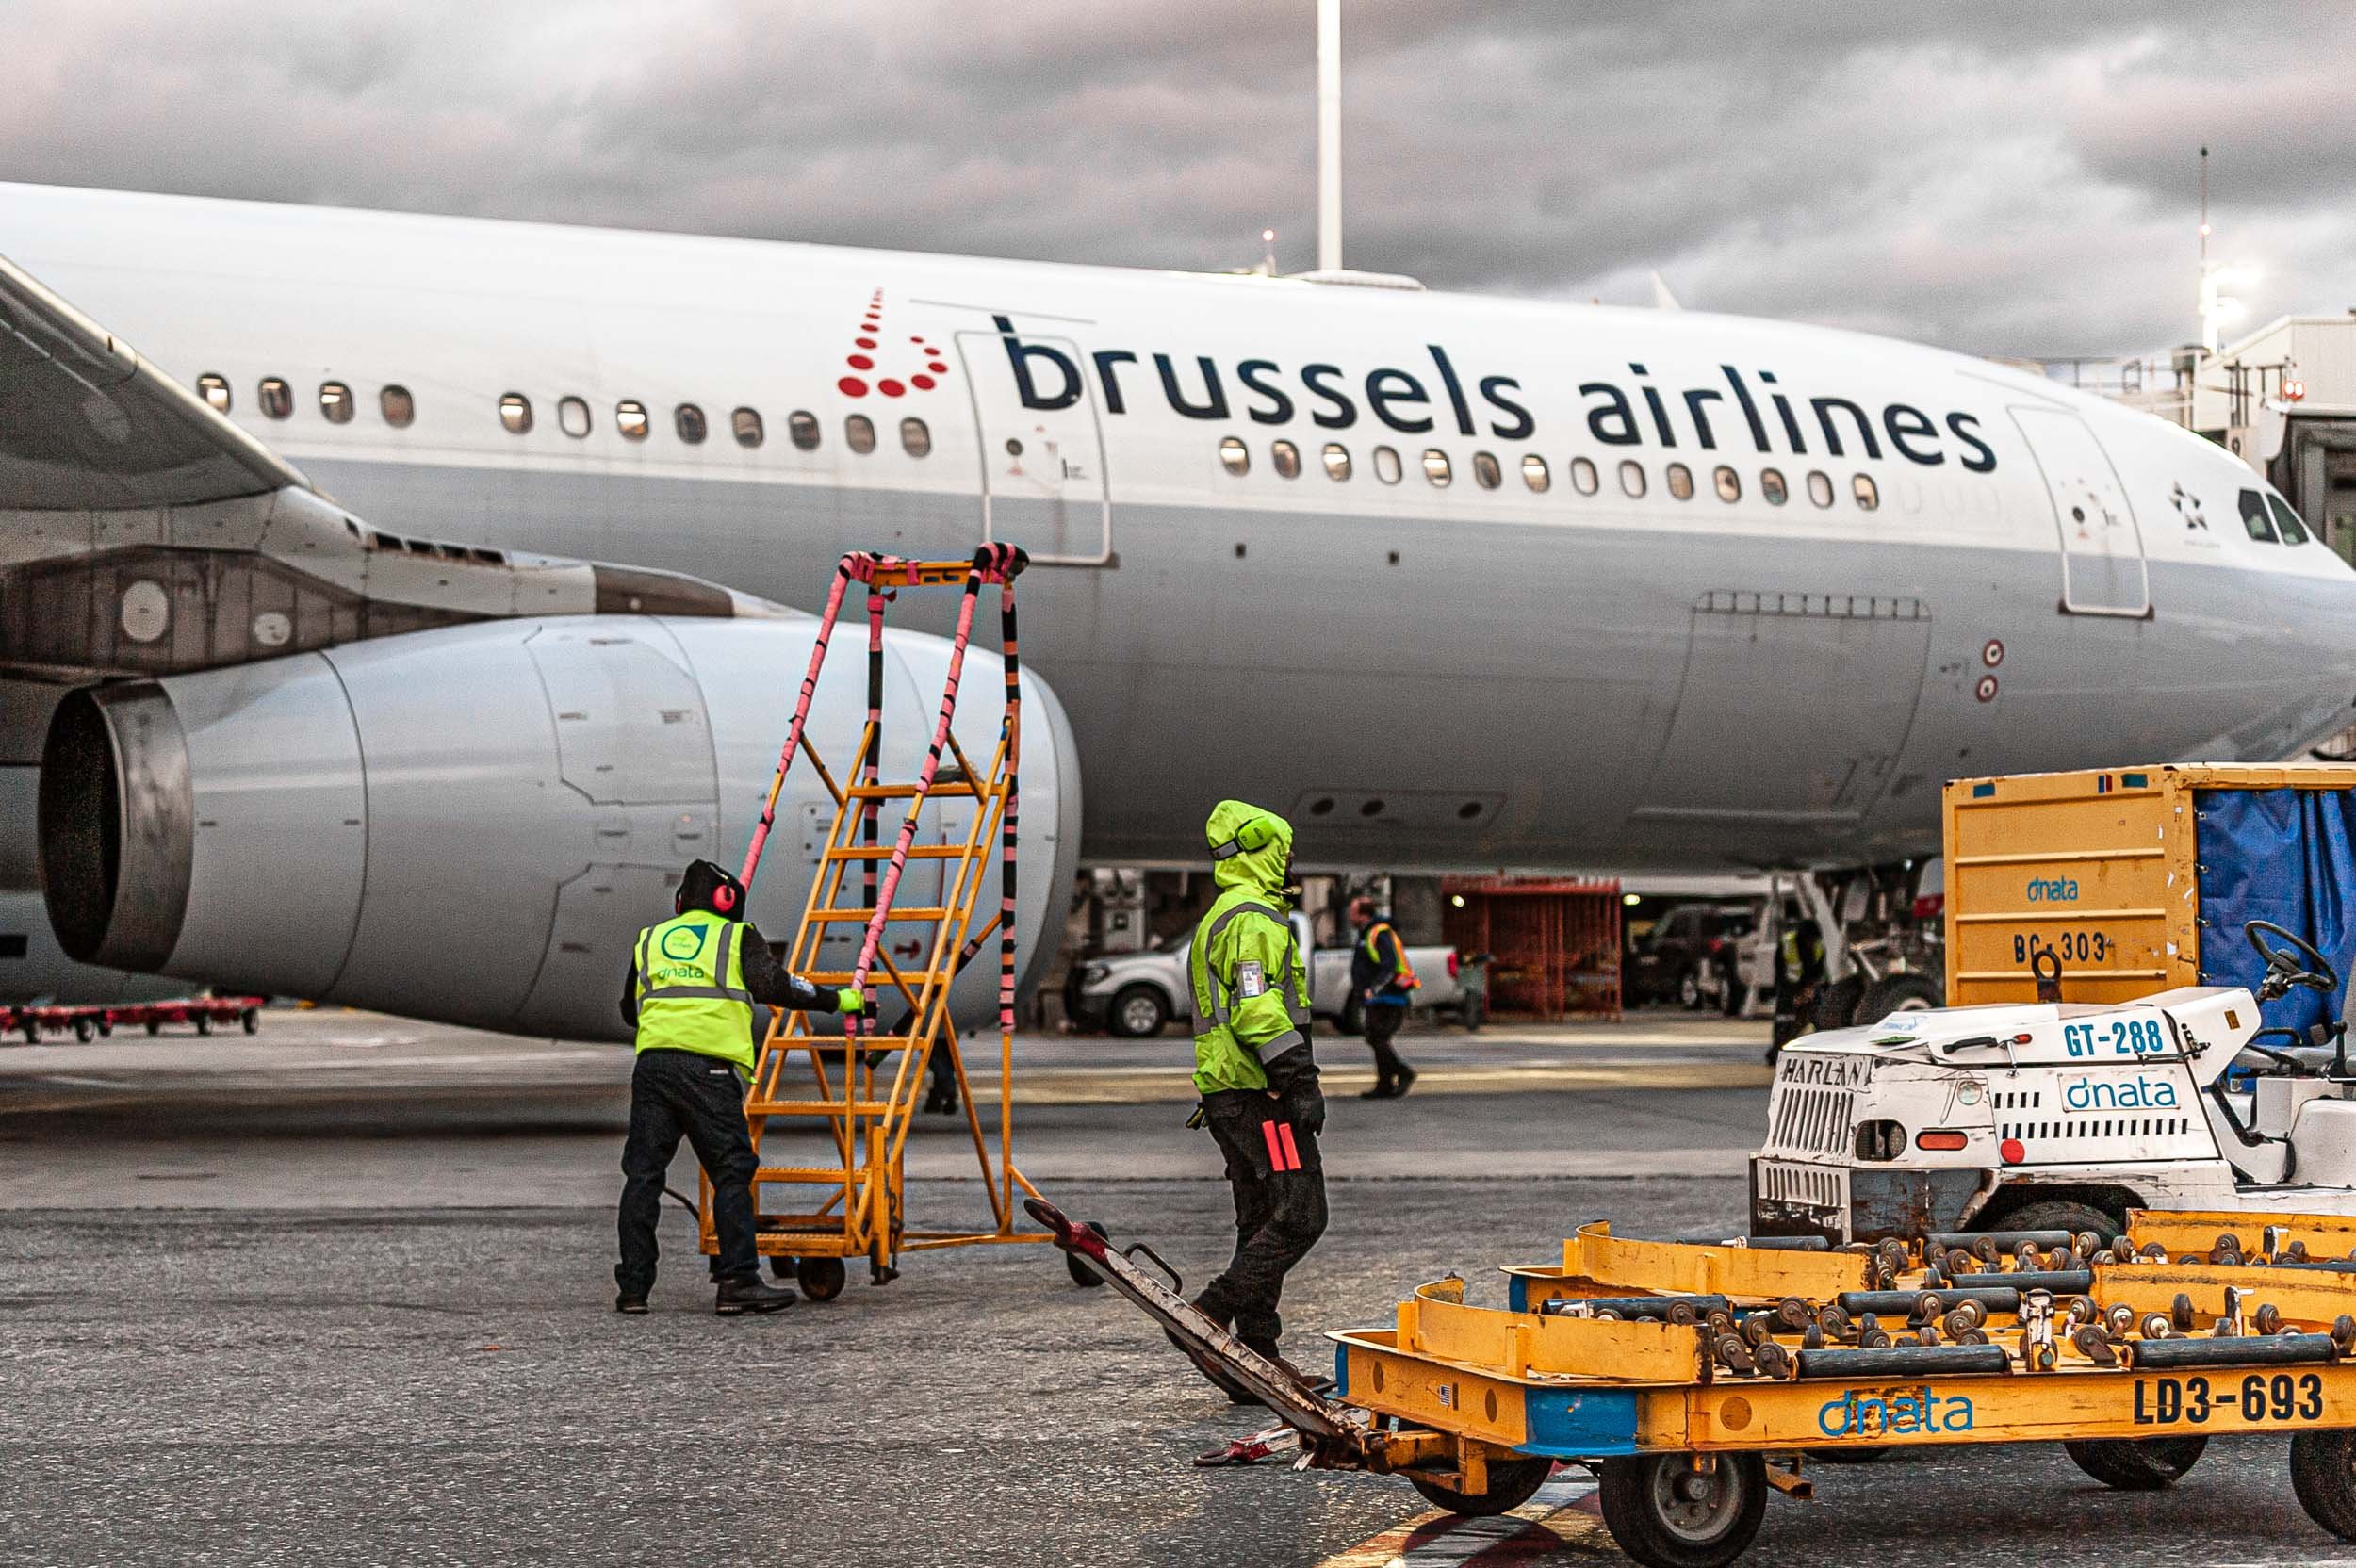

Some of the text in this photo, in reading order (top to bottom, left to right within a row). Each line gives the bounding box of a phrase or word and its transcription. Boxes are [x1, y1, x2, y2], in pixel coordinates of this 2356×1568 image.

[992, 315, 1997, 473] brussels airlines
[2027, 874, 2078, 902] dnata
[657, 964, 705, 980] dnata
[2064, 1020, 2164, 1057] GT-288
[1781, 1057, 1863, 1086] HARLAN
[2067, 1075, 2177, 1109] dnata
[1818, 1385, 1973, 1437] dnata
[2134, 1373, 2323, 1425] LD3-693
